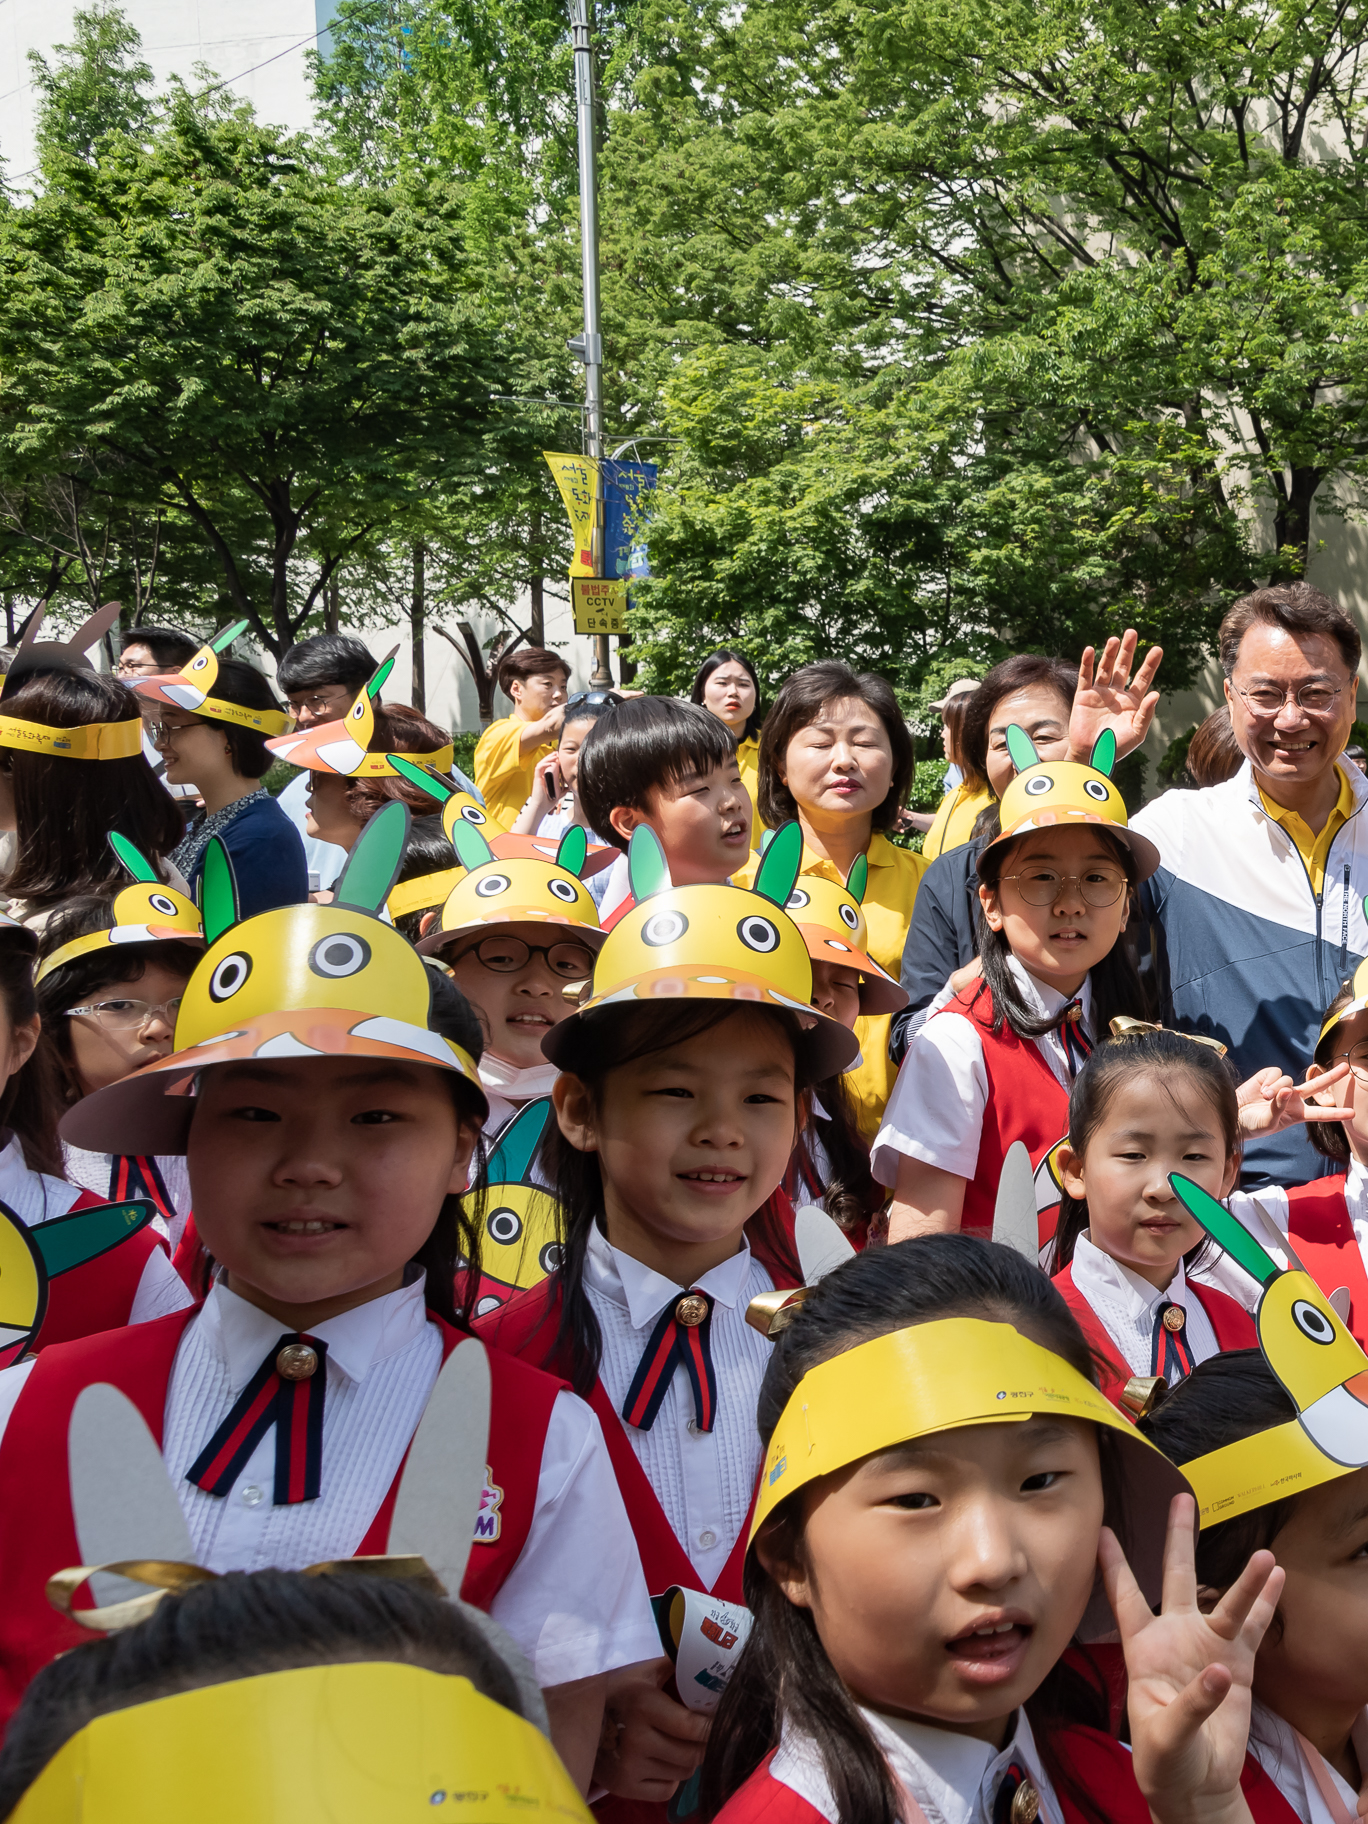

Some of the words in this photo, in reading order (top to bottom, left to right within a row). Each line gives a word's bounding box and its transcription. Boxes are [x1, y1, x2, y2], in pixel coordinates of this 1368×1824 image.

[562, 463, 588, 485] 서울
[618, 469, 645, 491] 서울
[572, 488, 591, 505] 동화
[586, 597, 615, 606] CCTV
